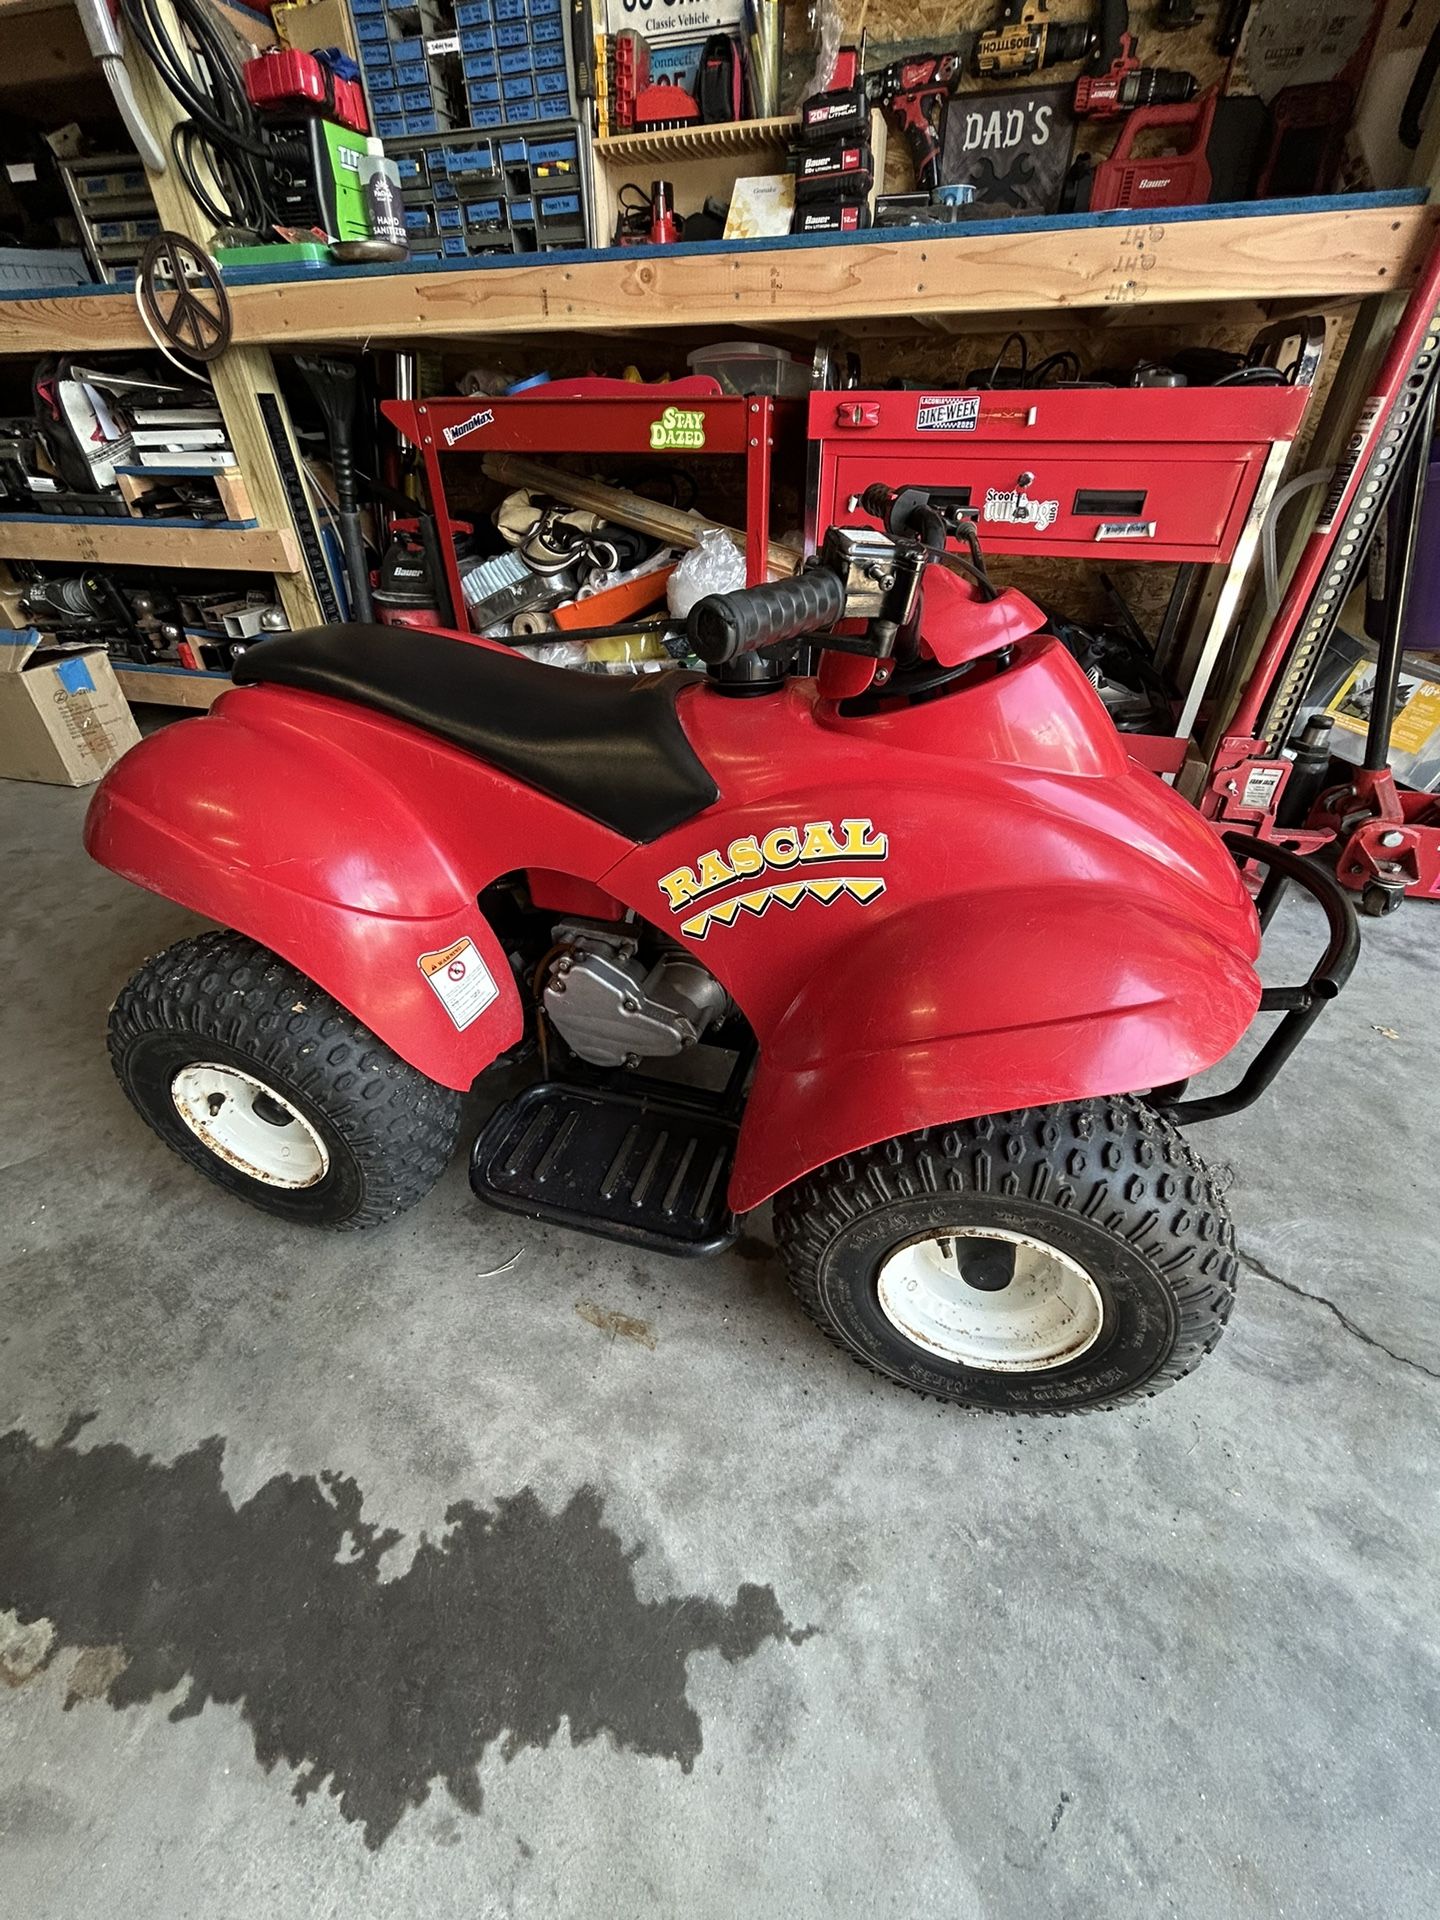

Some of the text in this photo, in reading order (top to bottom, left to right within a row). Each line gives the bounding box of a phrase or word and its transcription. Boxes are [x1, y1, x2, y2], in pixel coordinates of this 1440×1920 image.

[646, 12, 710, 31] Classic Vehicle
[983, 36, 1030, 54] BOSTITCH
[828, 108, 857, 119] LITHIUM
[829, 104, 850, 114] Bauer
[963, 101, 1052, 152] DAD'S
[805, 158, 831, 168] Bauer
[1139, 177, 1171, 190] Bauer
[376, 216, 400, 226] HAND
[805, 215, 831, 225] Bauer
[373, 226, 407, 237] SANITIZER
[663, 407, 703, 429] STAY
[919, 401, 977, 425] BIKE WEEK
[450, 411, 493, 439] MonoMax
[651, 424, 704, 446] DAZED
[393, 566, 424, 577] Bauer
[658, 818, 888, 915] RASCAL
[438, 945, 463, 966] WARNING
